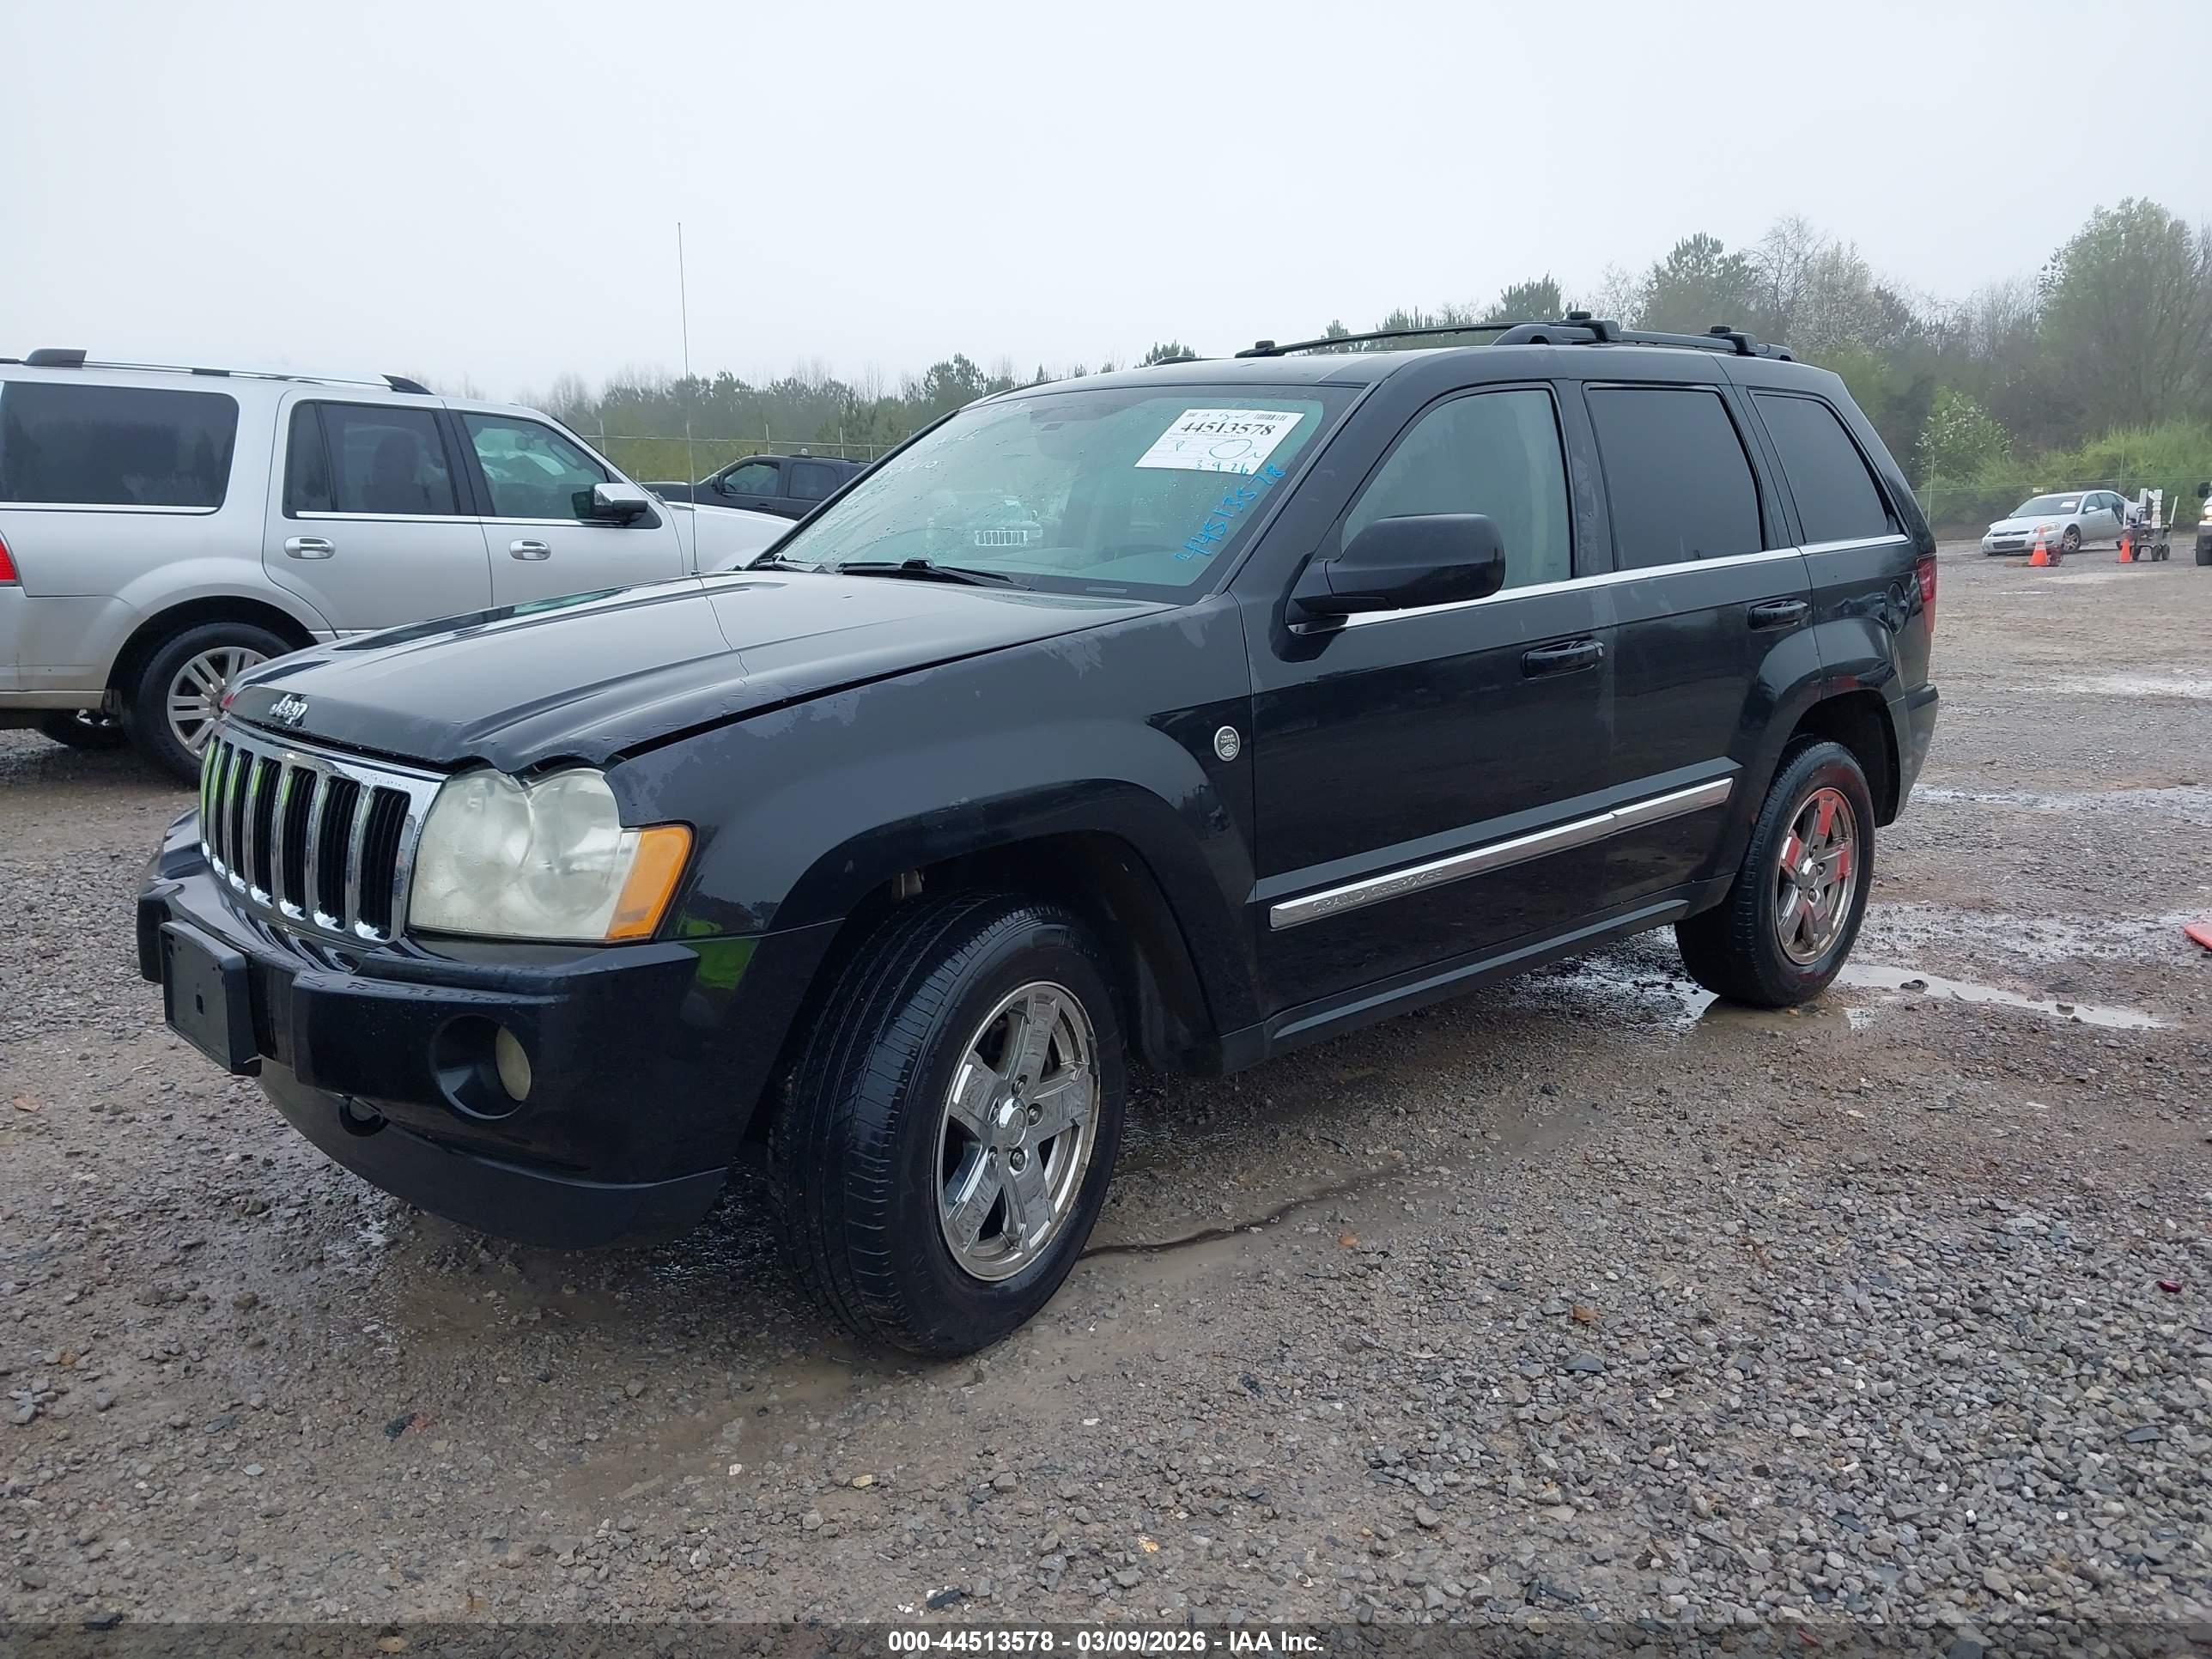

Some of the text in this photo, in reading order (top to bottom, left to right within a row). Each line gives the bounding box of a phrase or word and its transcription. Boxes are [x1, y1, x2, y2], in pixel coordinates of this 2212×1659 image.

[1181, 421, 1276, 436] 44513578
[1174, 462, 1286, 561] 44513578
[268, 694, 308, 725] Jeep
[1312, 868, 1443, 913] GRAND CHEROKEE
